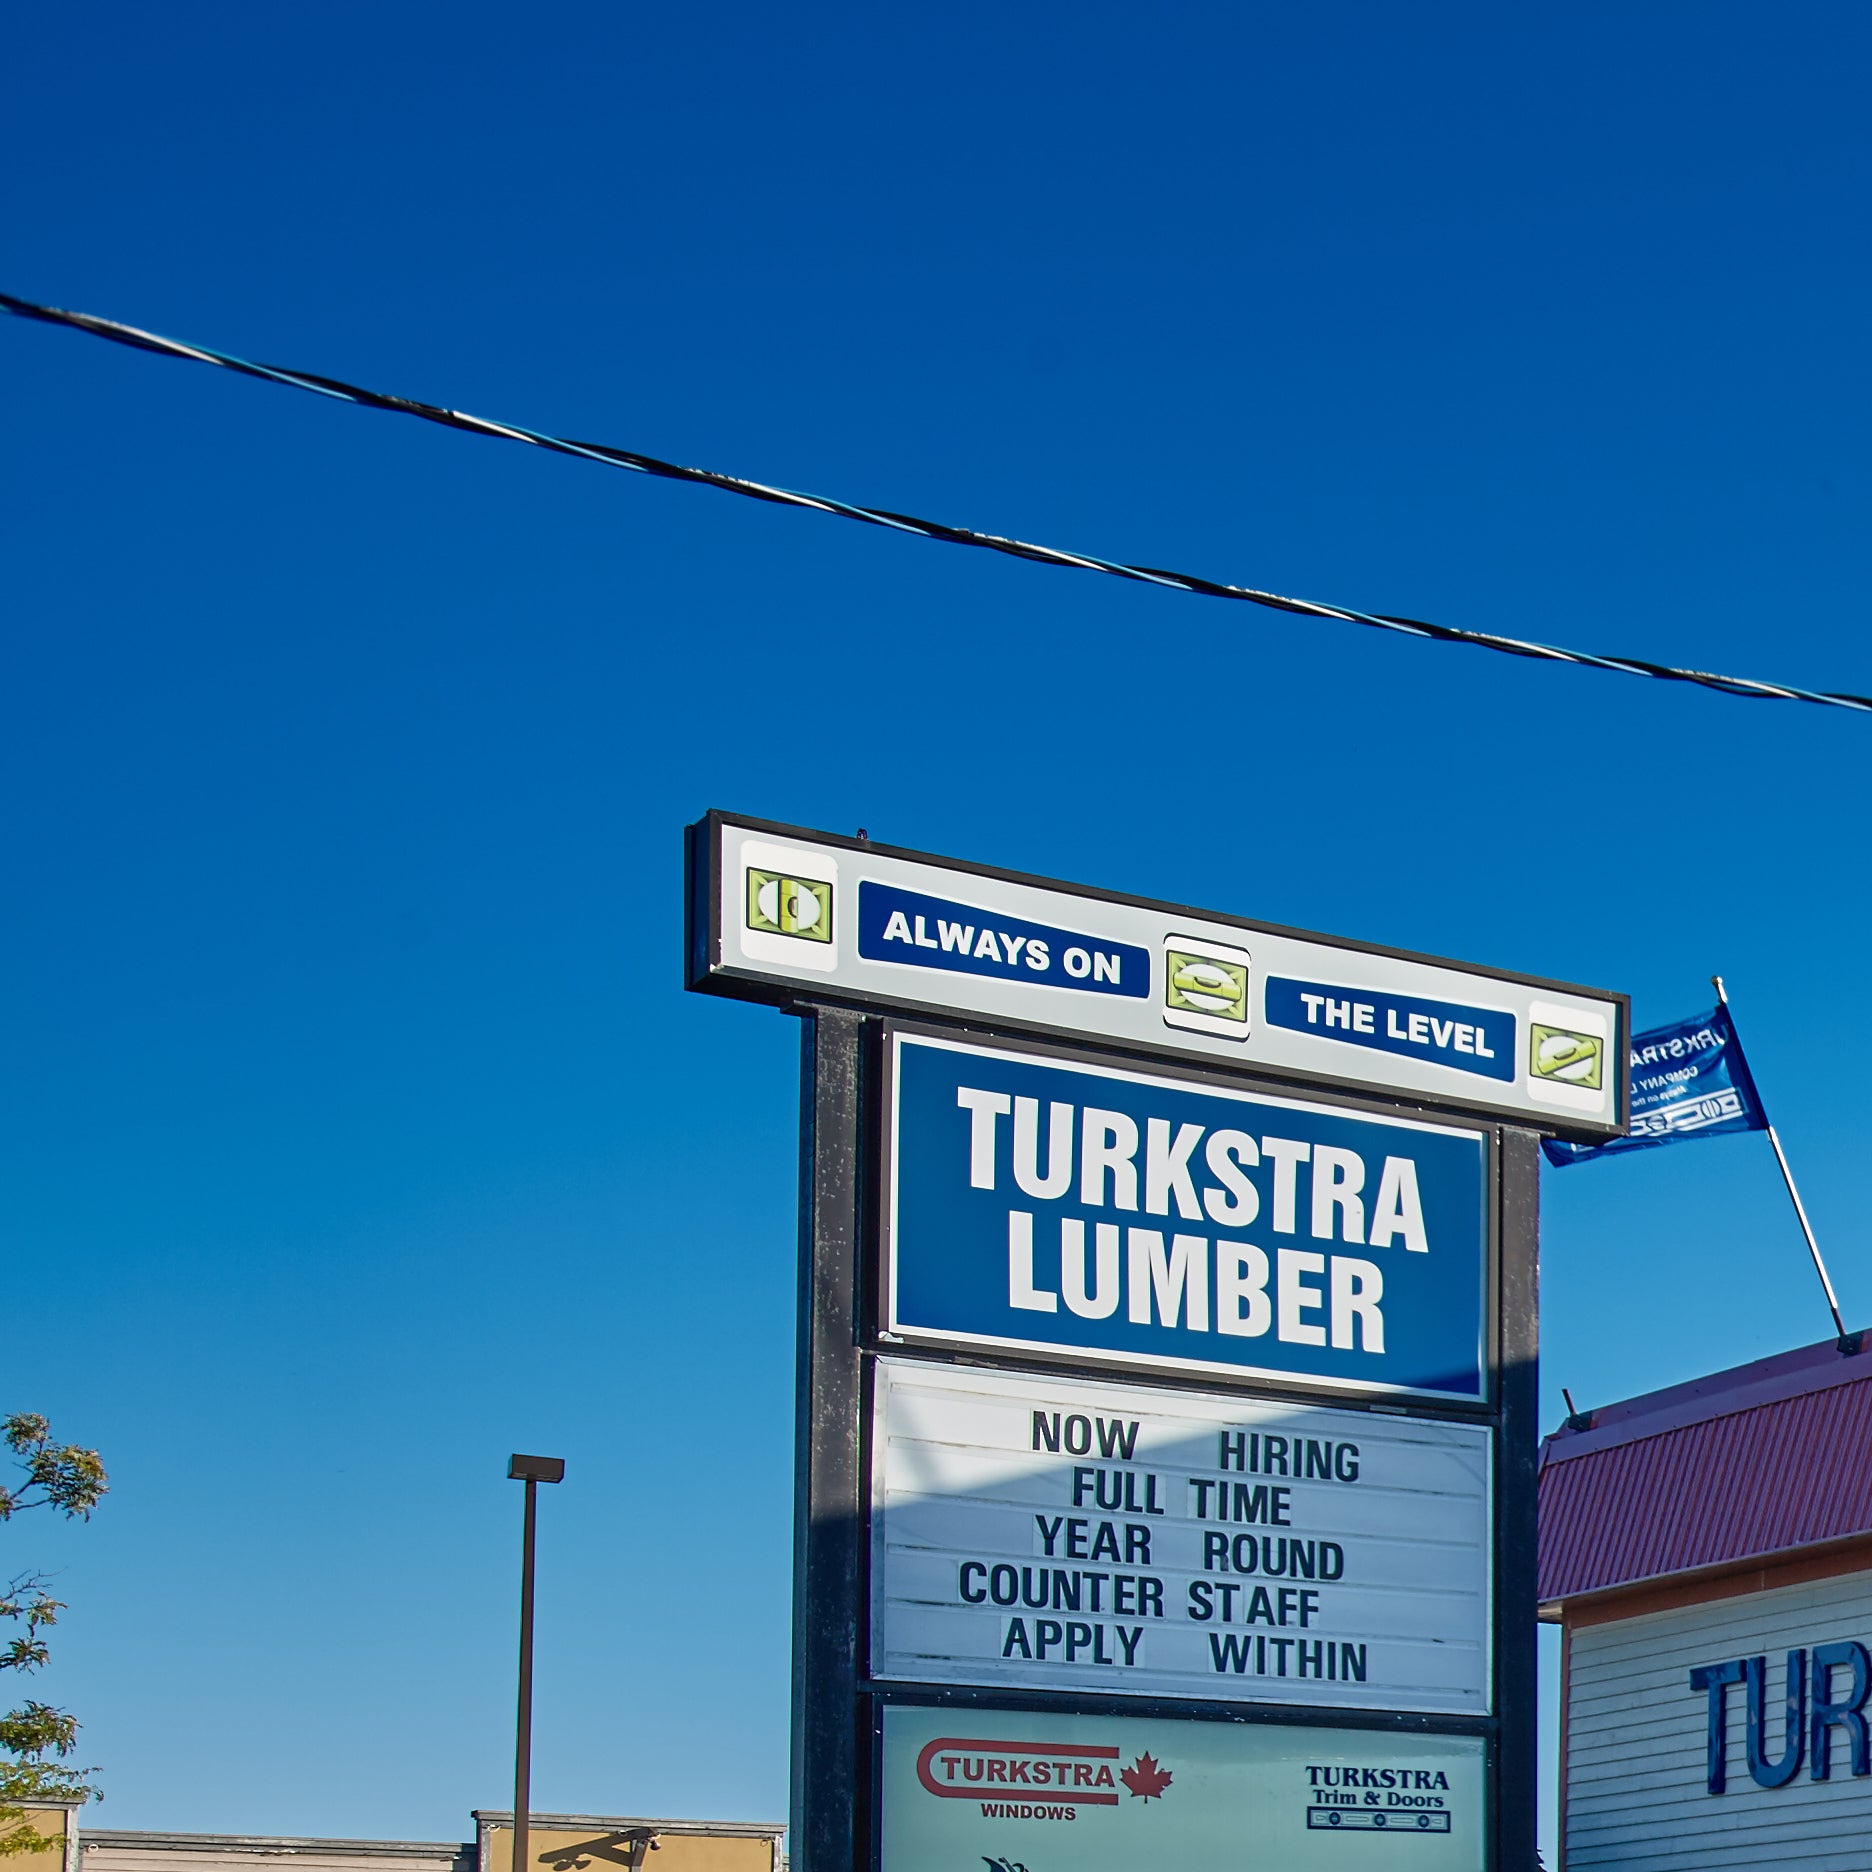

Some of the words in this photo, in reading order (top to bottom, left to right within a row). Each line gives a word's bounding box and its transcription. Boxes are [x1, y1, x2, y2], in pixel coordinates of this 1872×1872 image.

[882, 909, 1051, 971] ALWAYS
[1062, 945, 1123, 986] ON
[1300, 993, 1375, 1034] THE
[1386, 1008, 1496, 1060] LEVEL
[957, 1086, 1429, 1254] TURKSTRA
[1008, 1211, 1385, 1353] LUMBER
[1032, 1410, 1140, 1461] NOW
[1219, 1430, 1361, 1483] HIRING
[1072, 1467, 1165, 1515] FULL
[1189, 1478, 1292, 1526] TIME
[1034, 1514, 1152, 1564] YEAR
[1204, 1531, 1345, 1580] ROUND
[958, 1561, 1165, 1617] COUNTER
[1188, 1580, 1321, 1628] STAFF
[1002, 1617, 1144, 1666] APPLY
[1209, 1632, 1368, 1682] WITHIN
[941, 1757, 1116, 1787] TURKSTRA
[1305, 1766, 1450, 1790] TURKSTRA
[1313, 1789, 1357, 1805] Trim
[1363, 1791, 1381, 1806] &
[1387, 1792, 1444, 1808] Doors
[981, 1803, 1076, 1821] WINDOWS
